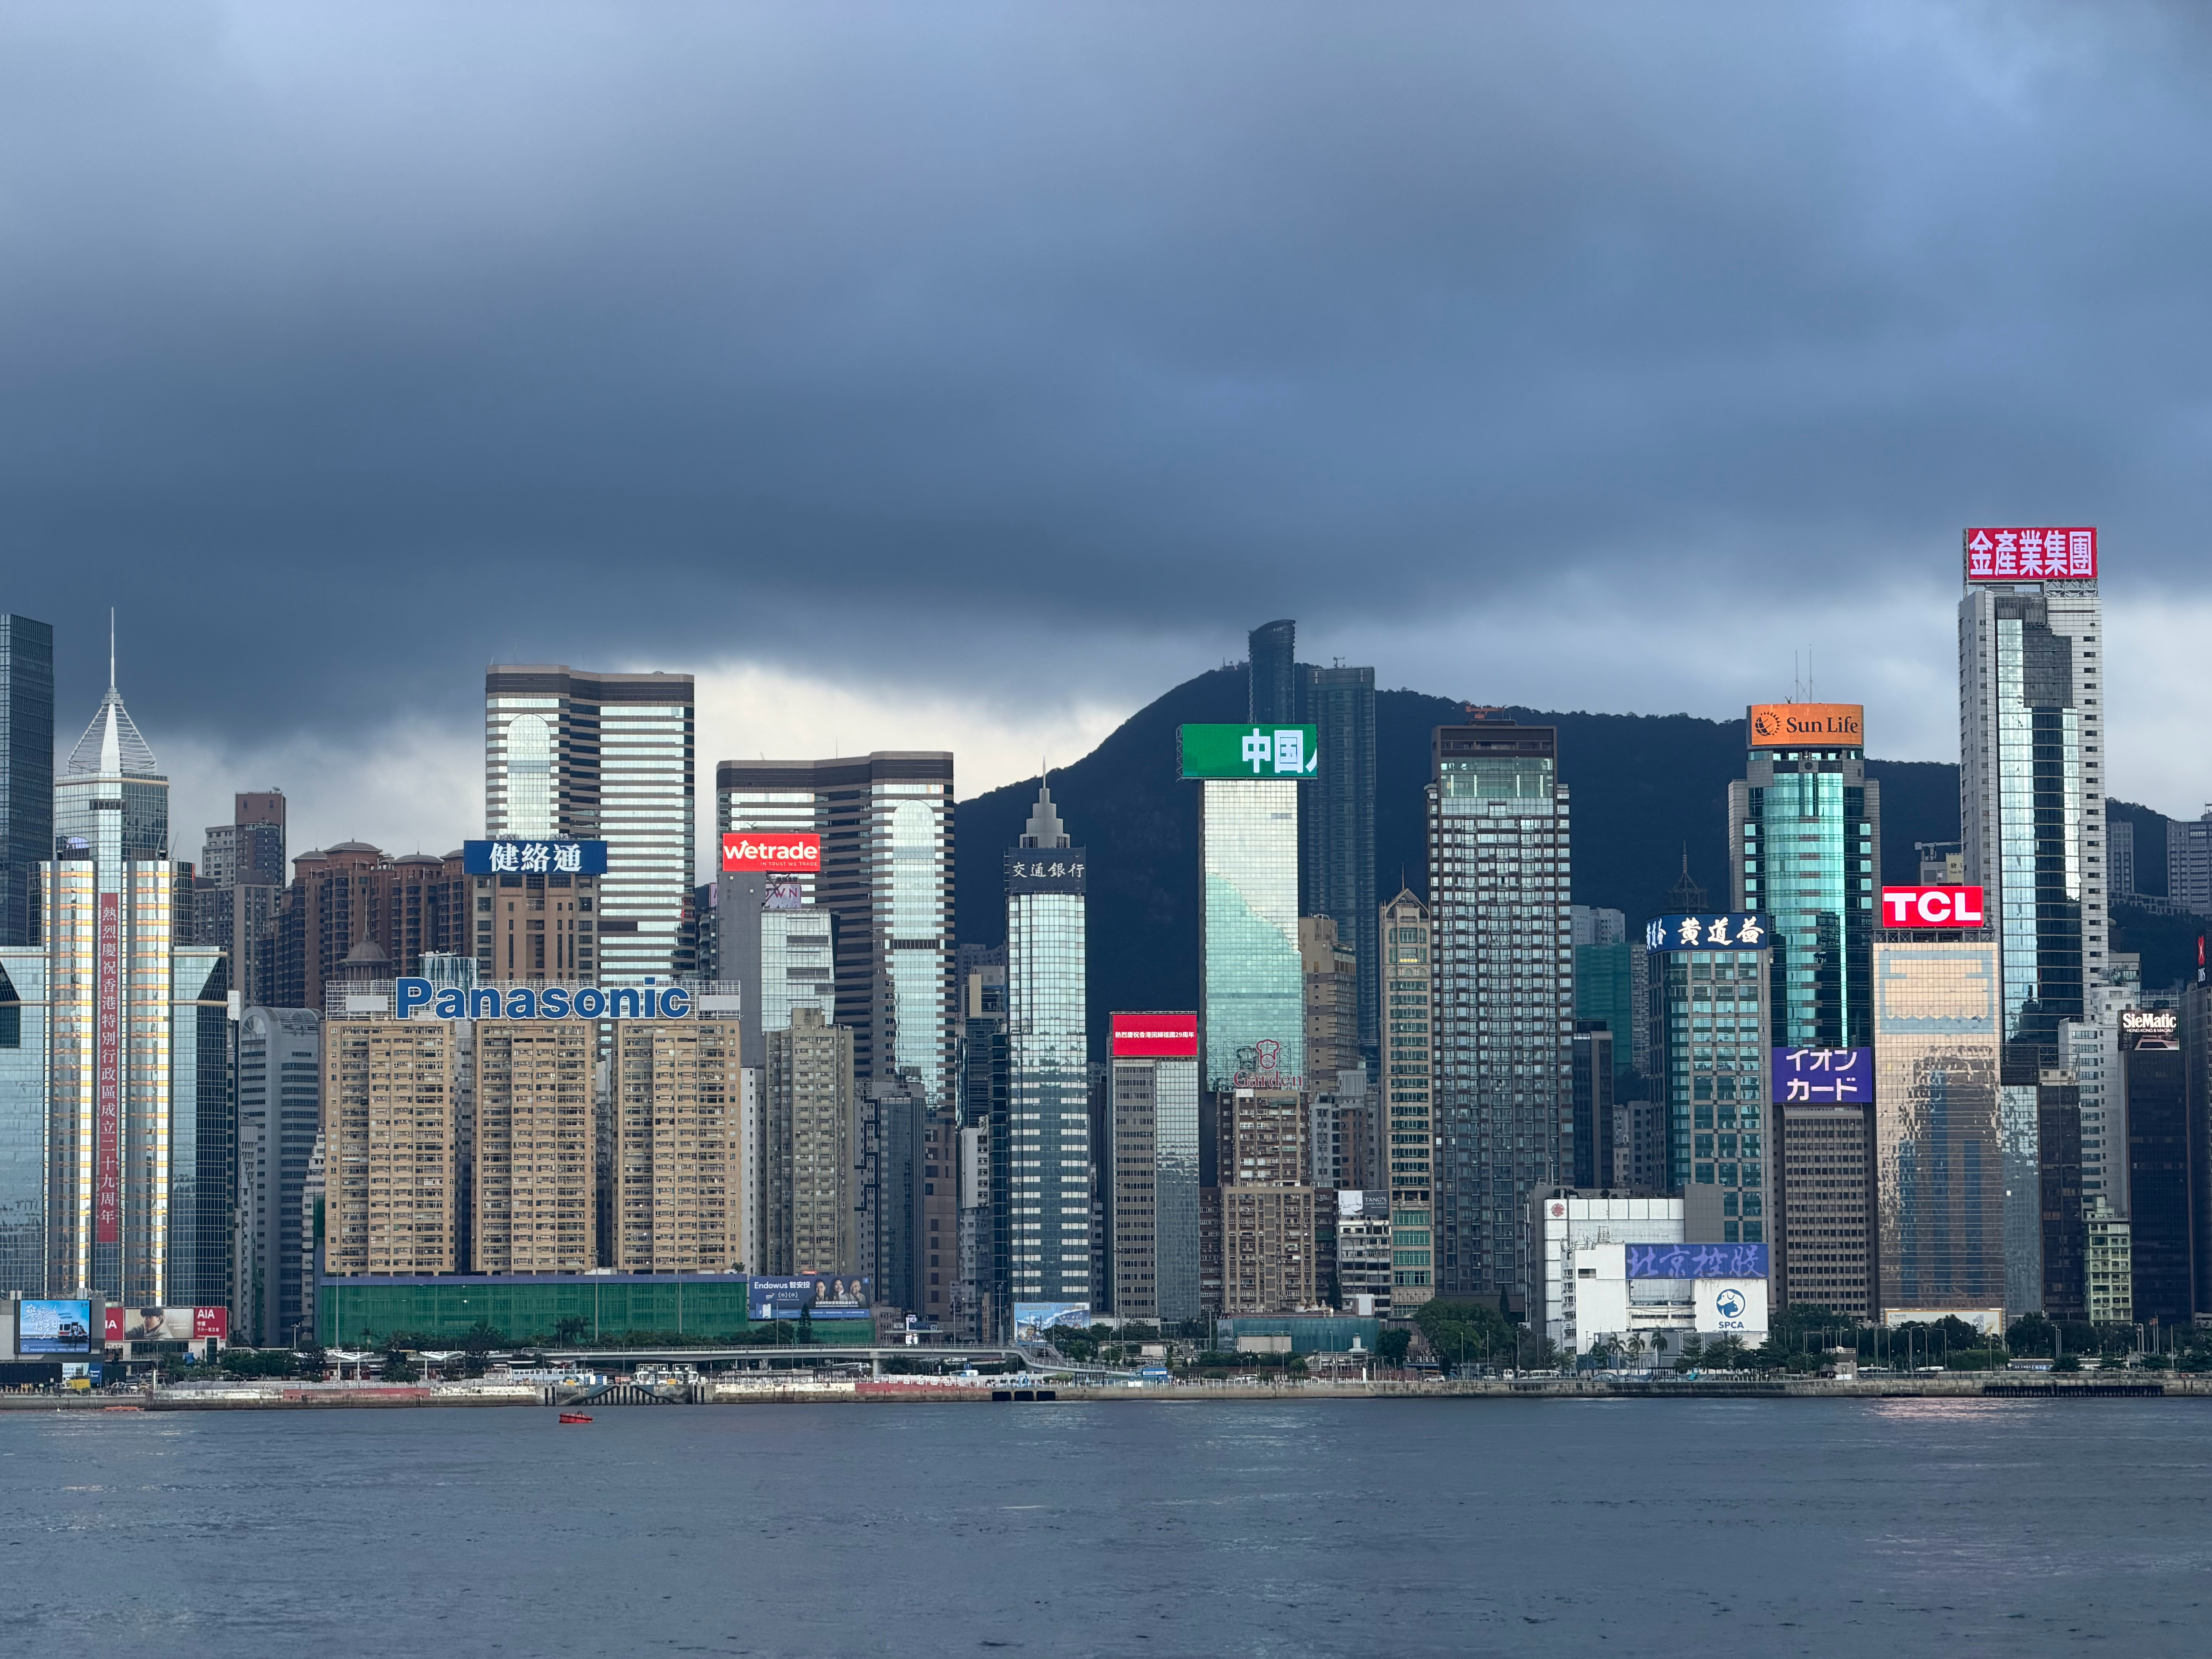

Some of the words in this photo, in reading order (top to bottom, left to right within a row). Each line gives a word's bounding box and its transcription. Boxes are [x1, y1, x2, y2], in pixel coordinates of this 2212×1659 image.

[1969, 530, 2092, 576] 金產業集團
[1786, 717, 1822, 733] Sun
[1826, 716, 1858, 733] Life
[489, 842, 583, 872] 健絡通
[1013, 862, 1085, 878] 交通銀行
[1884, 891, 1981, 922] TCL
[396, 976, 690, 1020] Panasonic
[2123, 1013, 2177, 1028] SieMatic
[101, 907, 117, 1224] 熱烈慶祝香港特別行政區成立二十九周年
[1786, 1049, 1858, 1072] イオン
[1233, 1070, 1303, 1087] Garden
[1787, 1077, 1858, 1101] カード
[1627, 1245, 1765, 1278] 北京控股
[105, 1320, 117, 1329] IA
[198, 1309, 215, 1319] AIA
